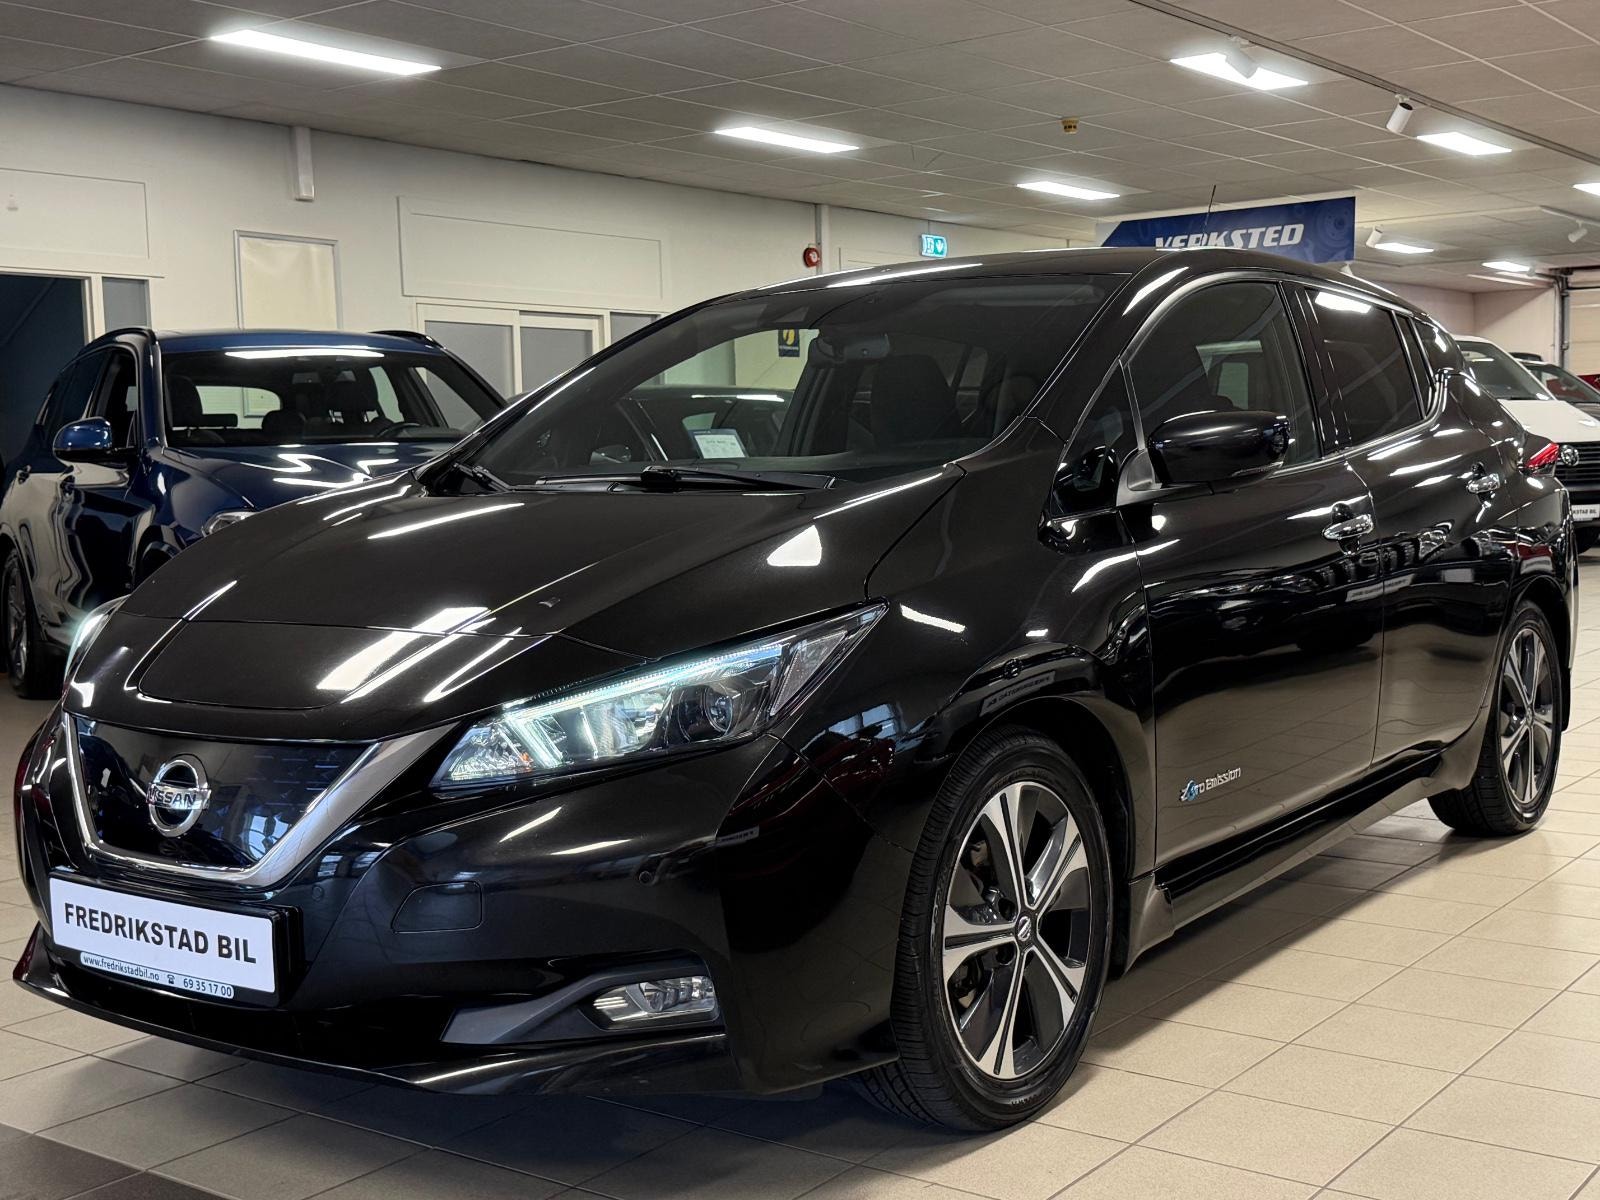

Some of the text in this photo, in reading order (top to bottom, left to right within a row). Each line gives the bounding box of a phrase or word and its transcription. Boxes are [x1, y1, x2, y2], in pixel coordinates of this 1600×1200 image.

[1205, 767, 1241, 791] Emission
[147, 785, 197, 807] NISSAN
[64, 902, 257, 964] FREDRIKSTAD BIL
[83, 956, 232, 997] www.fredrikstadbil.no 69 35 17 00
